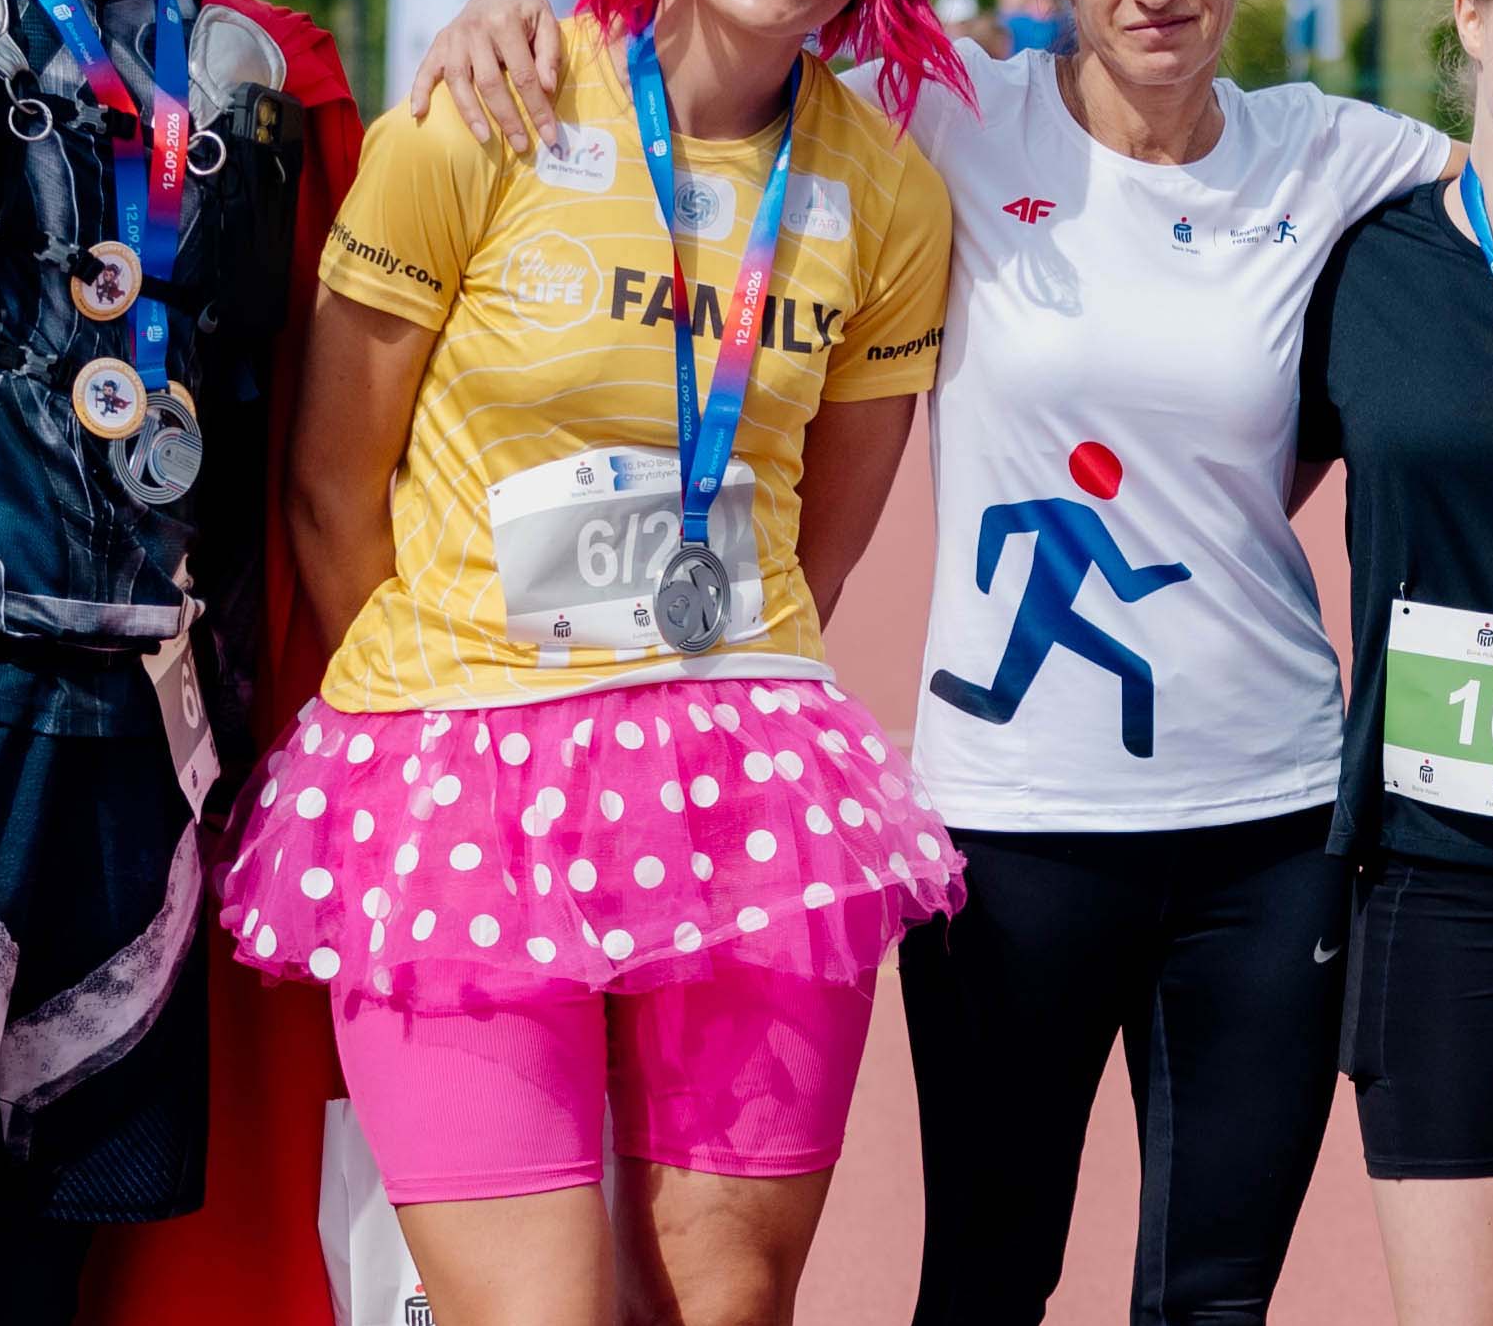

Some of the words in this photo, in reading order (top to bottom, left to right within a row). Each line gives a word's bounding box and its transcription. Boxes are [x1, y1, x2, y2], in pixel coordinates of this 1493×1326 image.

[163, 112, 181, 189] 12.09.2026
[124, 203, 142, 263] 12.09.2
[1002, 197, 1057, 223] 4F
[518, 247, 588, 281] Happy
[517, 282, 584, 305] LIFE
[610, 266, 842, 353] FAMILY
[735, 271, 764, 347] 12.09.2026
[866, 326, 945, 361] happylif
[678, 362, 694, 442] 12.09.2026
[623, 469, 683, 485] Charytatywn
